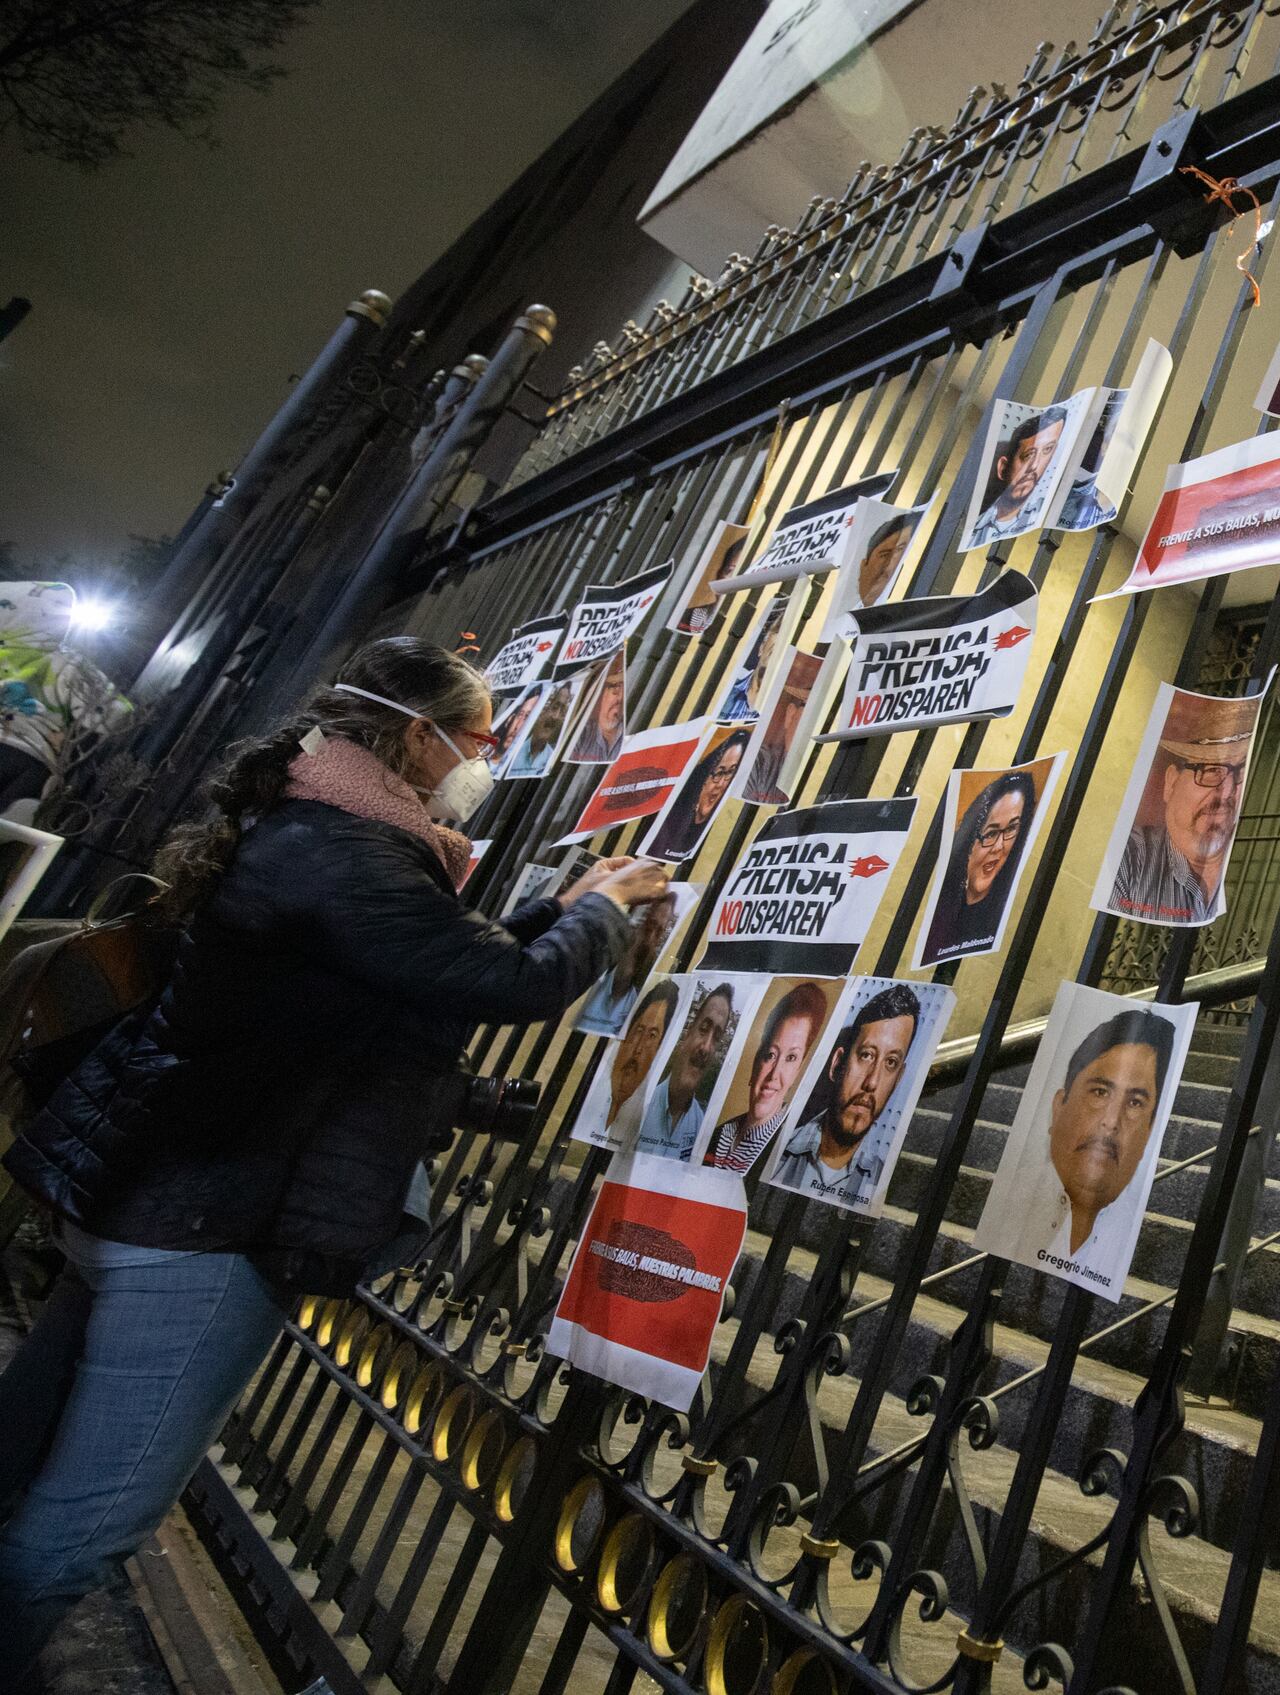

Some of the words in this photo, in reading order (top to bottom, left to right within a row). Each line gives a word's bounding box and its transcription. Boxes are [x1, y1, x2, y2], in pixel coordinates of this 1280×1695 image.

[1157, 529, 1195, 548] FRENTE
[1193, 527, 1202, 540] A
[1203, 521, 1224, 537] SUS
[1224, 512, 1261, 532] BALAS,
[858, 625, 992, 691] PRENSA,
[728, 843, 847, 907] PRENSA,
[837, 1185, 871, 1206] Espinosa
[1037, 1249, 1080, 1273] Gregorio
